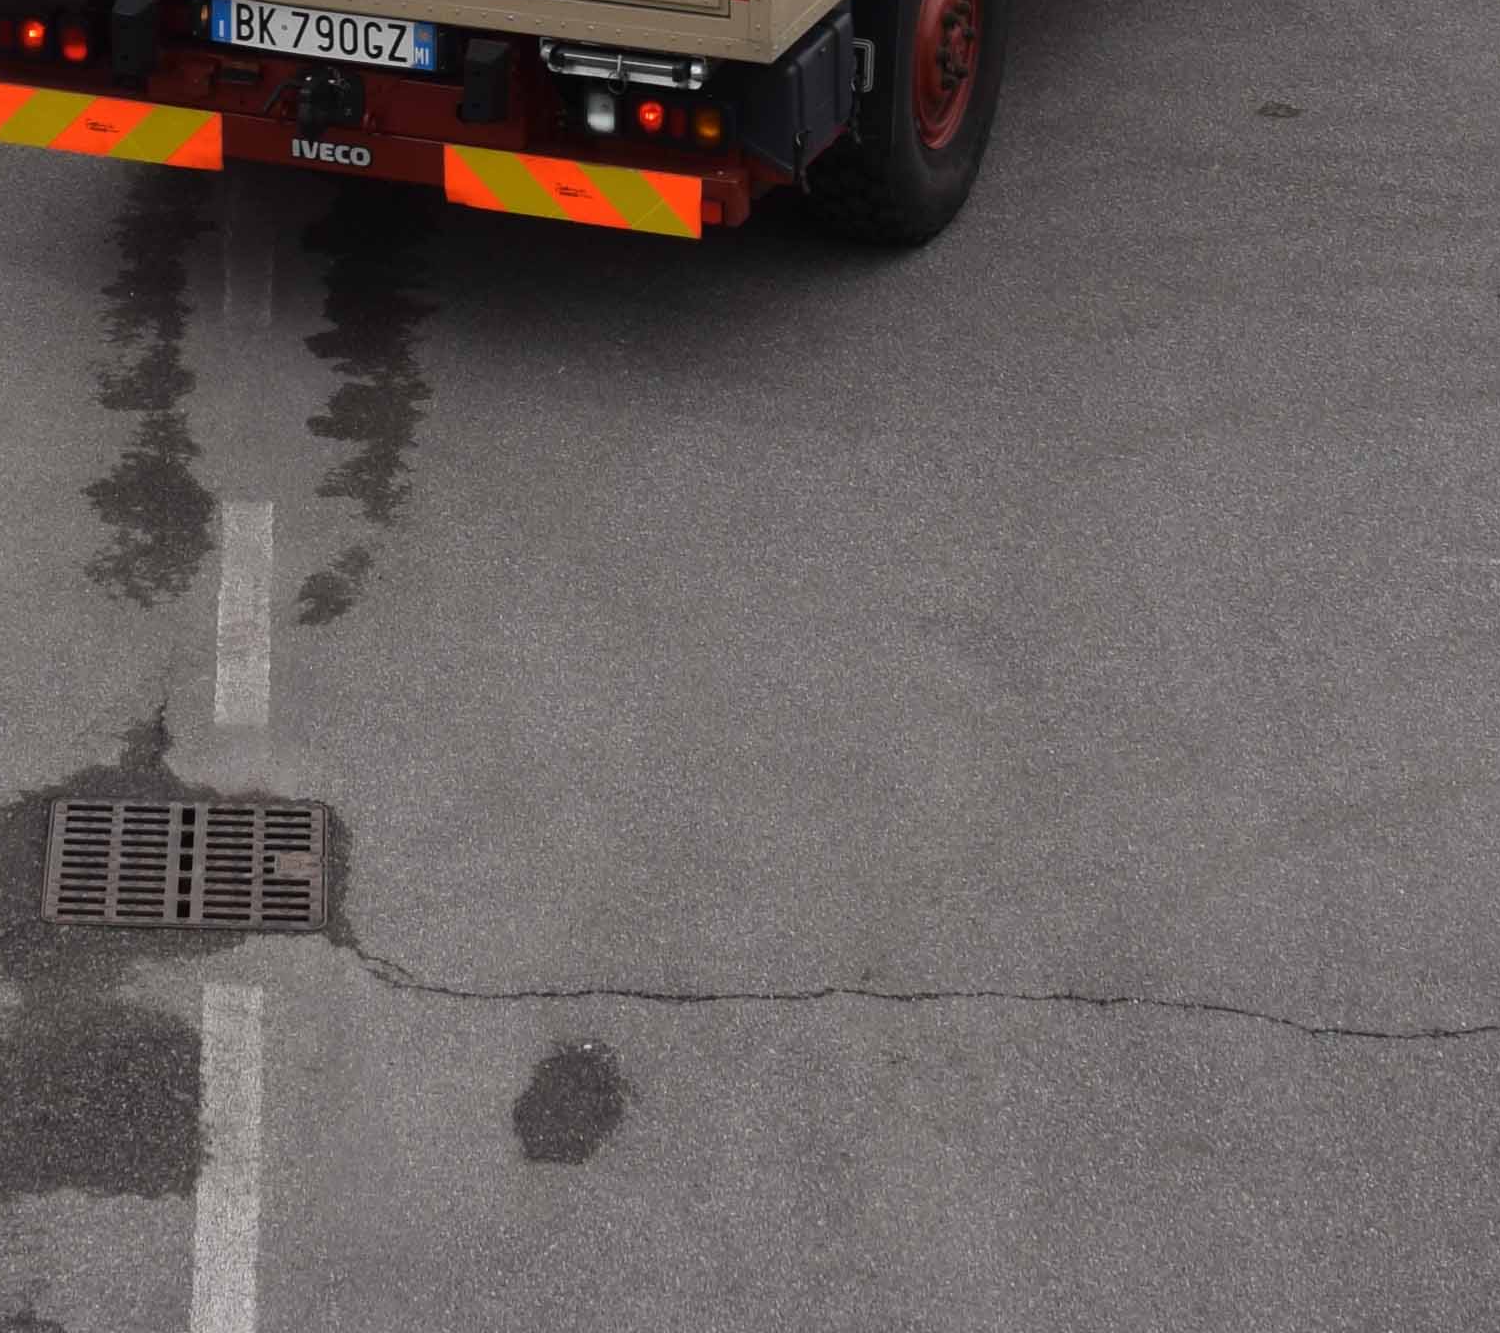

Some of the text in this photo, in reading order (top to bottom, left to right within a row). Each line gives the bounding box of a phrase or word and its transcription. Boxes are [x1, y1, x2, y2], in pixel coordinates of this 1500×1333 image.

[291, 11, 409, 64] 790GZ
[414, 47, 430, 66] MI
[291, 138, 372, 167] IVECO
